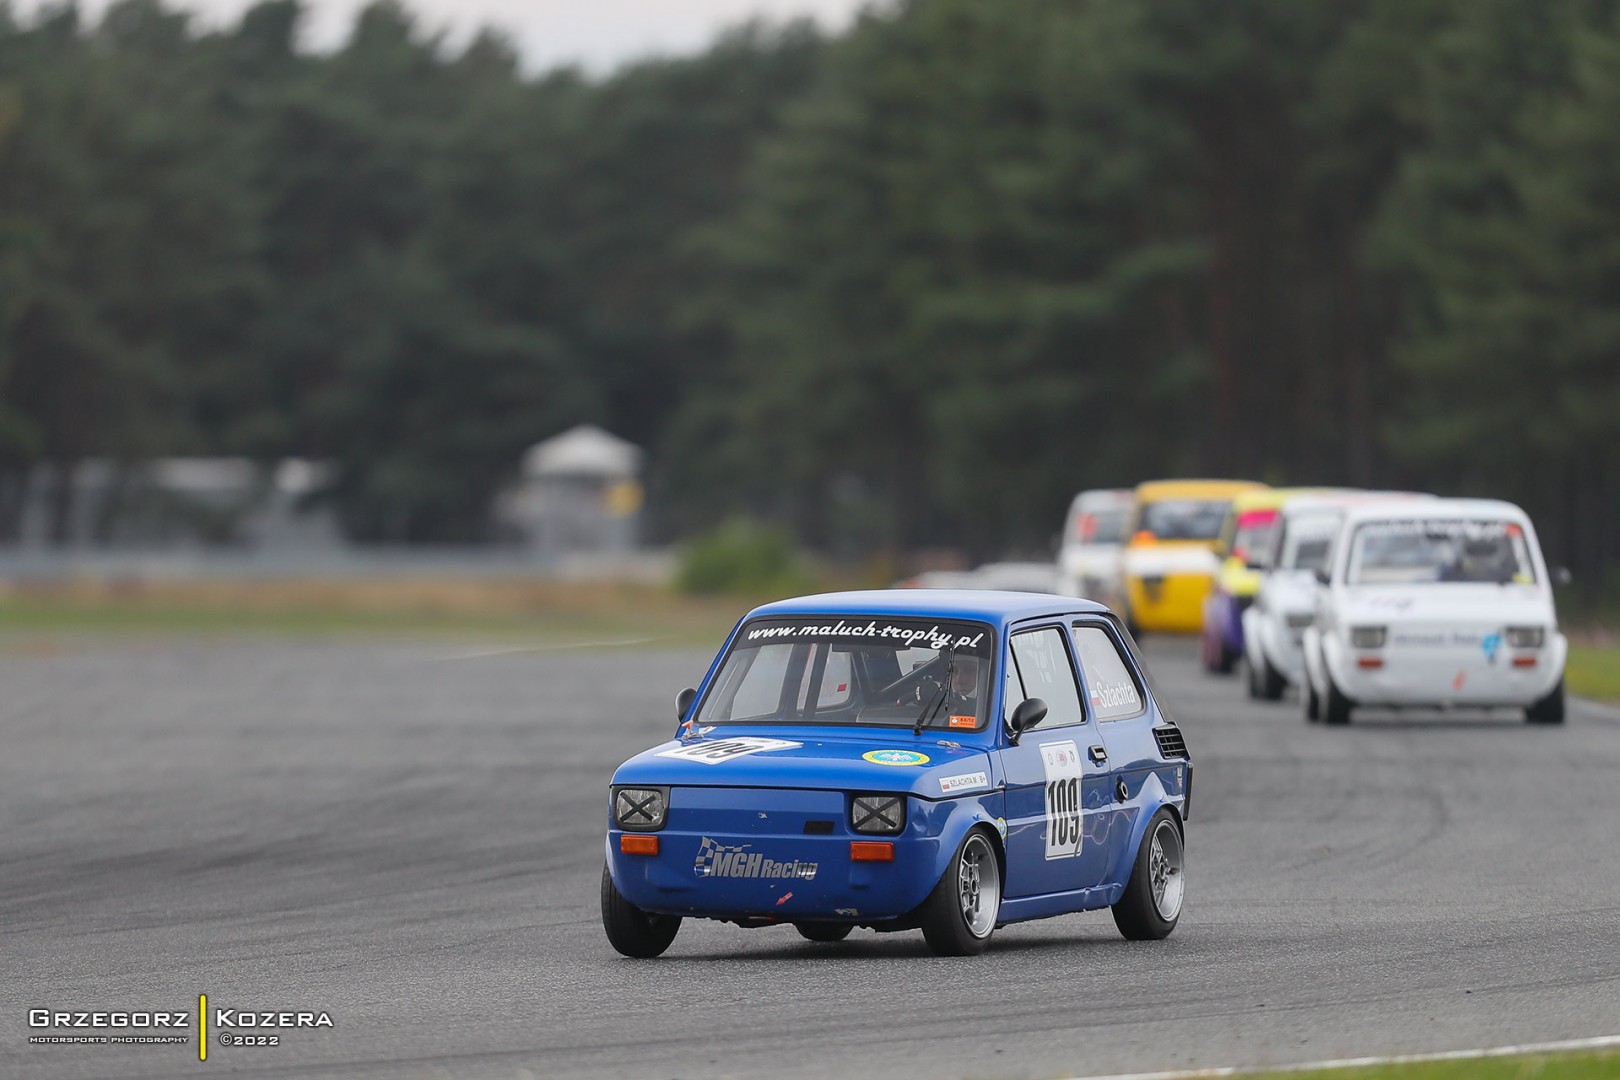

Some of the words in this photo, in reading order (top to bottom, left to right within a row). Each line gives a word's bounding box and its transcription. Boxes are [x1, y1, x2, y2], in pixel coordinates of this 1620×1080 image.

[748, 620, 984, 649] www.maluch-trophy.pl
[673, 741, 764, 759] 109
[1047, 777, 1079, 846] 109
[710, 852, 763, 878] MGH
[760, 859, 818, 880] Racing
